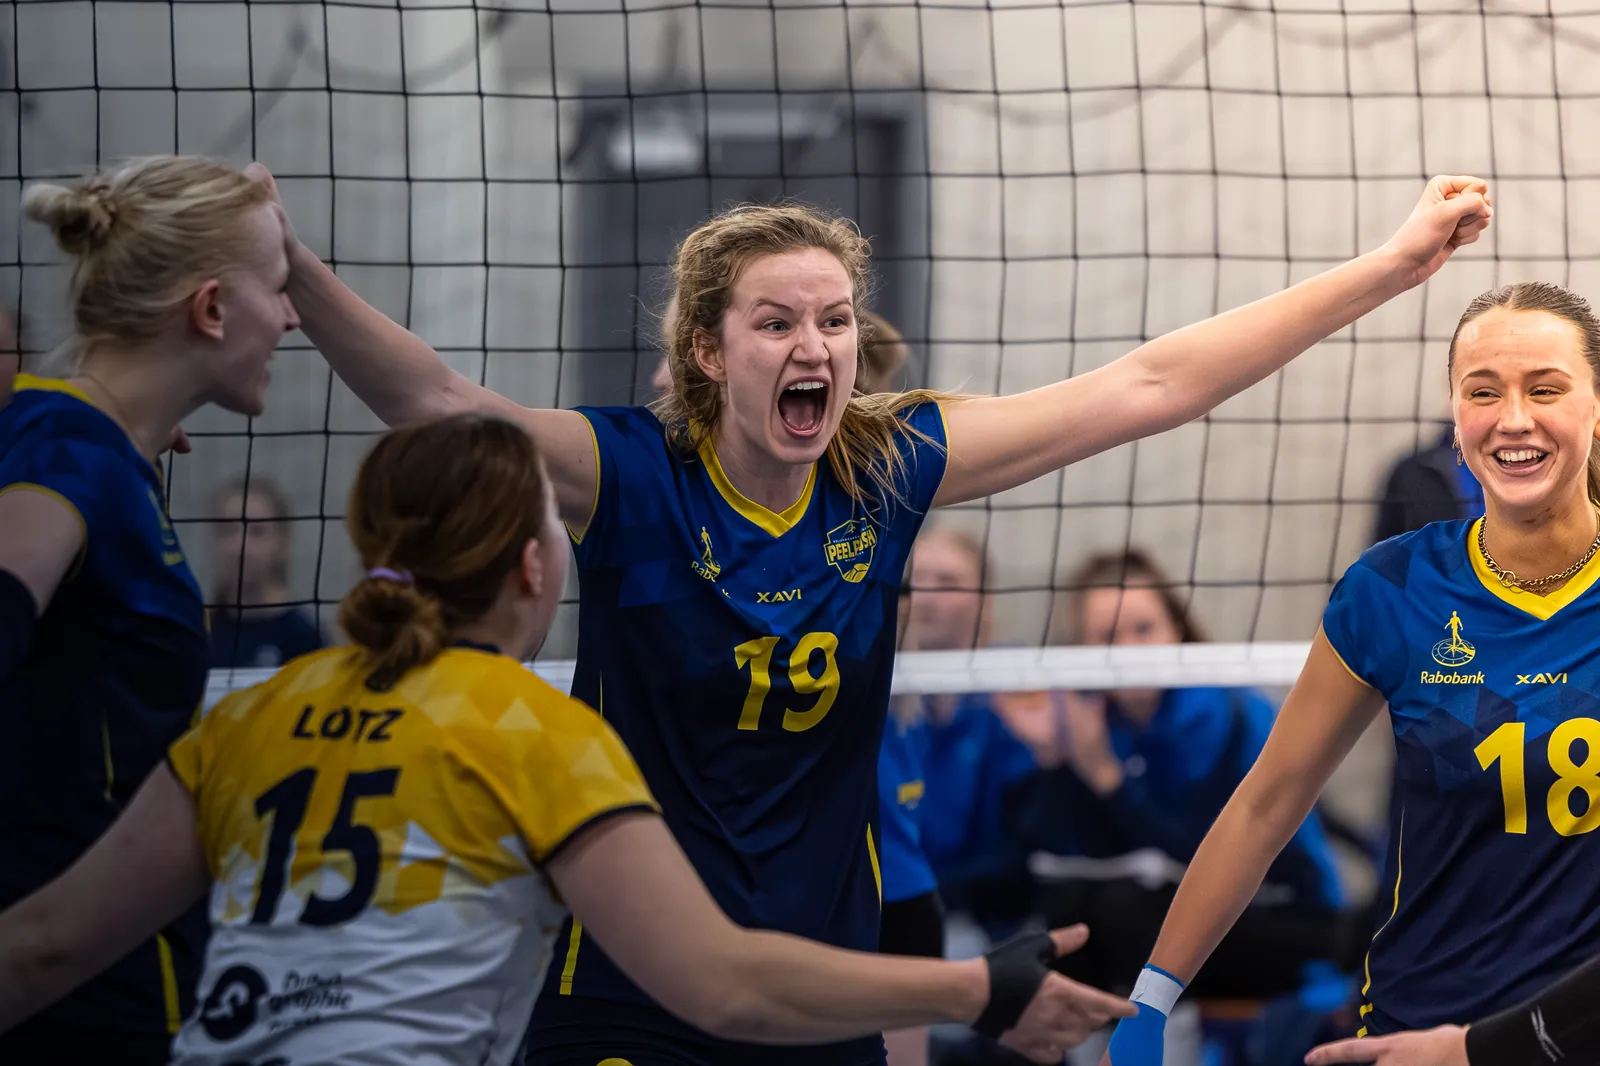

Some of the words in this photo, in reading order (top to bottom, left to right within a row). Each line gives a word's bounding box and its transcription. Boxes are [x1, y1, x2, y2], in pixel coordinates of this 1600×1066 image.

[756, 589, 802, 604] XAVI
[734, 632, 840, 732] 19
[1420, 670, 1485, 685] Rabobank
[1515, 672, 1567, 686] XAVI
[291, 704, 405, 743] LOTZ
[1474, 717, 1600, 837] 18
[249, 765, 402, 928] 15
